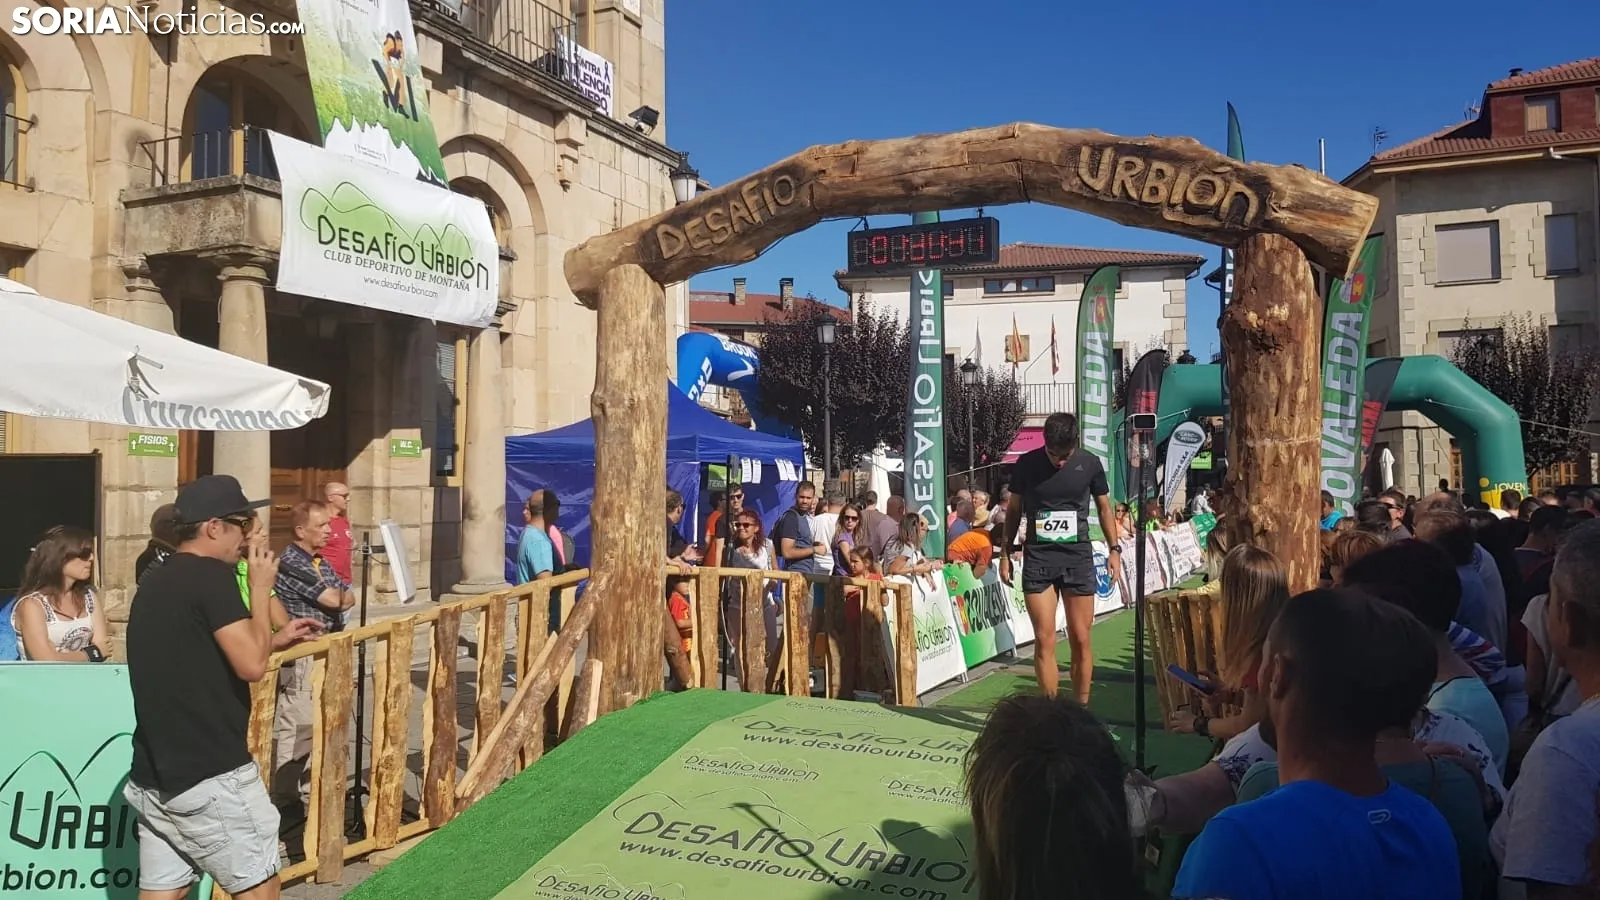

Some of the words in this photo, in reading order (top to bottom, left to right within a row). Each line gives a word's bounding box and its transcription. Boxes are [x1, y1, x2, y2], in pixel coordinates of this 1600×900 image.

[1076, 145, 1260, 230] URBIÓN
[317, 214, 416, 265] DESAFÍO
[420, 240, 489, 290] URBIÓN
[323, 249, 352, 264] CLUB
[355, 254, 412, 278] DEPORTIVO
[414, 271, 426, 282] DE
[428, 273, 470, 292] MONTAÑA
[363, 275, 439, 298] www.desafiourbion.com
[138, 435, 168, 445] FISIOS
[1494, 482, 1526, 493] JOVEN
[1043, 520, 1069, 531] 674
[743, 733, 962, 765] www.desafiourbion
[0, 862, 140, 891] bion.co
[619, 841, 948, 900] www.desafiourbion.com
